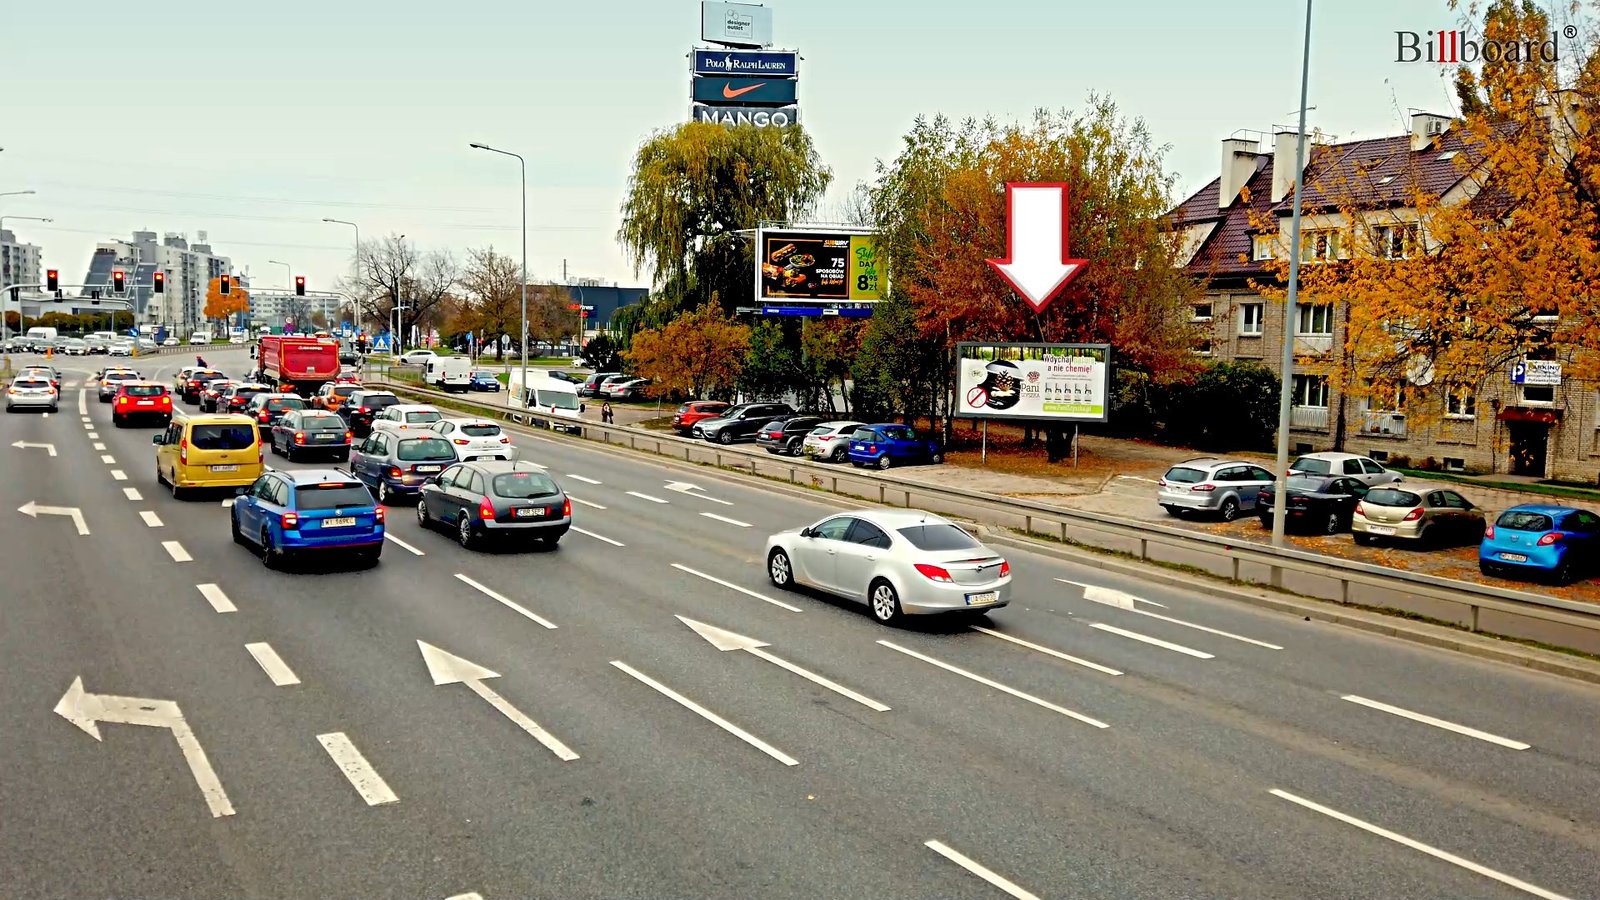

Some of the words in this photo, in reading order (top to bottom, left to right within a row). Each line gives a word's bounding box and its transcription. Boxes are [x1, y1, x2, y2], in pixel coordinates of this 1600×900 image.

[727, 19, 751, 27] designer
[705, 58, 725, 68] POLO
[733, 59, 758, 69] RALPH
[758, 60, 786, 70] LAUREN
[702, 110, 789, 128] MANGO
[831, 257, 845, 268] 75
[857, 275, 869, 291] 8
[1043, 355, 1072, 365] Wdychaj
[1053, 364, 1064, 372] nie
[1065, 365, 1093, 374] chemię!
[1021, 382, 1040, 392] Pani
